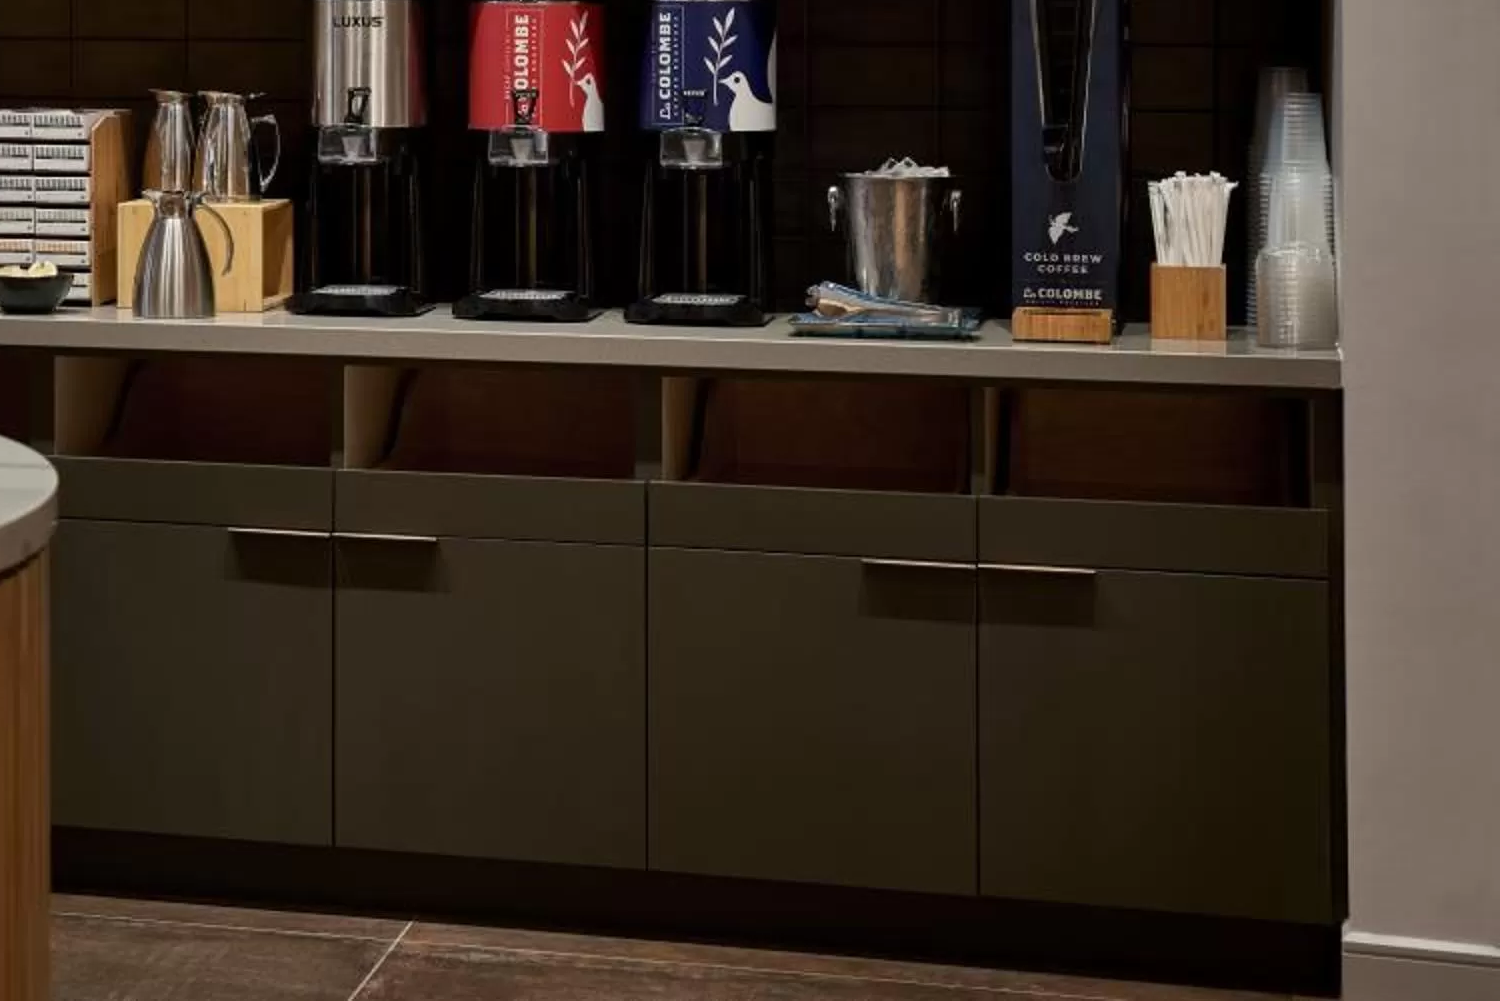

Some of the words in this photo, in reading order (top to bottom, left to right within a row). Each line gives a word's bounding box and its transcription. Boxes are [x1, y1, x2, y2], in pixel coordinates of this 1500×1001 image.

[332, 15, 384, 28] LUXUS
[659, 12, 671, 100] COLOMBE
[1024, 252, 1059, 262] COLD
[1063, 254, 1103, 264] BREW
[1037, 264, 1089, 274] COFFEE
[1038, 288, 1103, 300] COLOMBE
